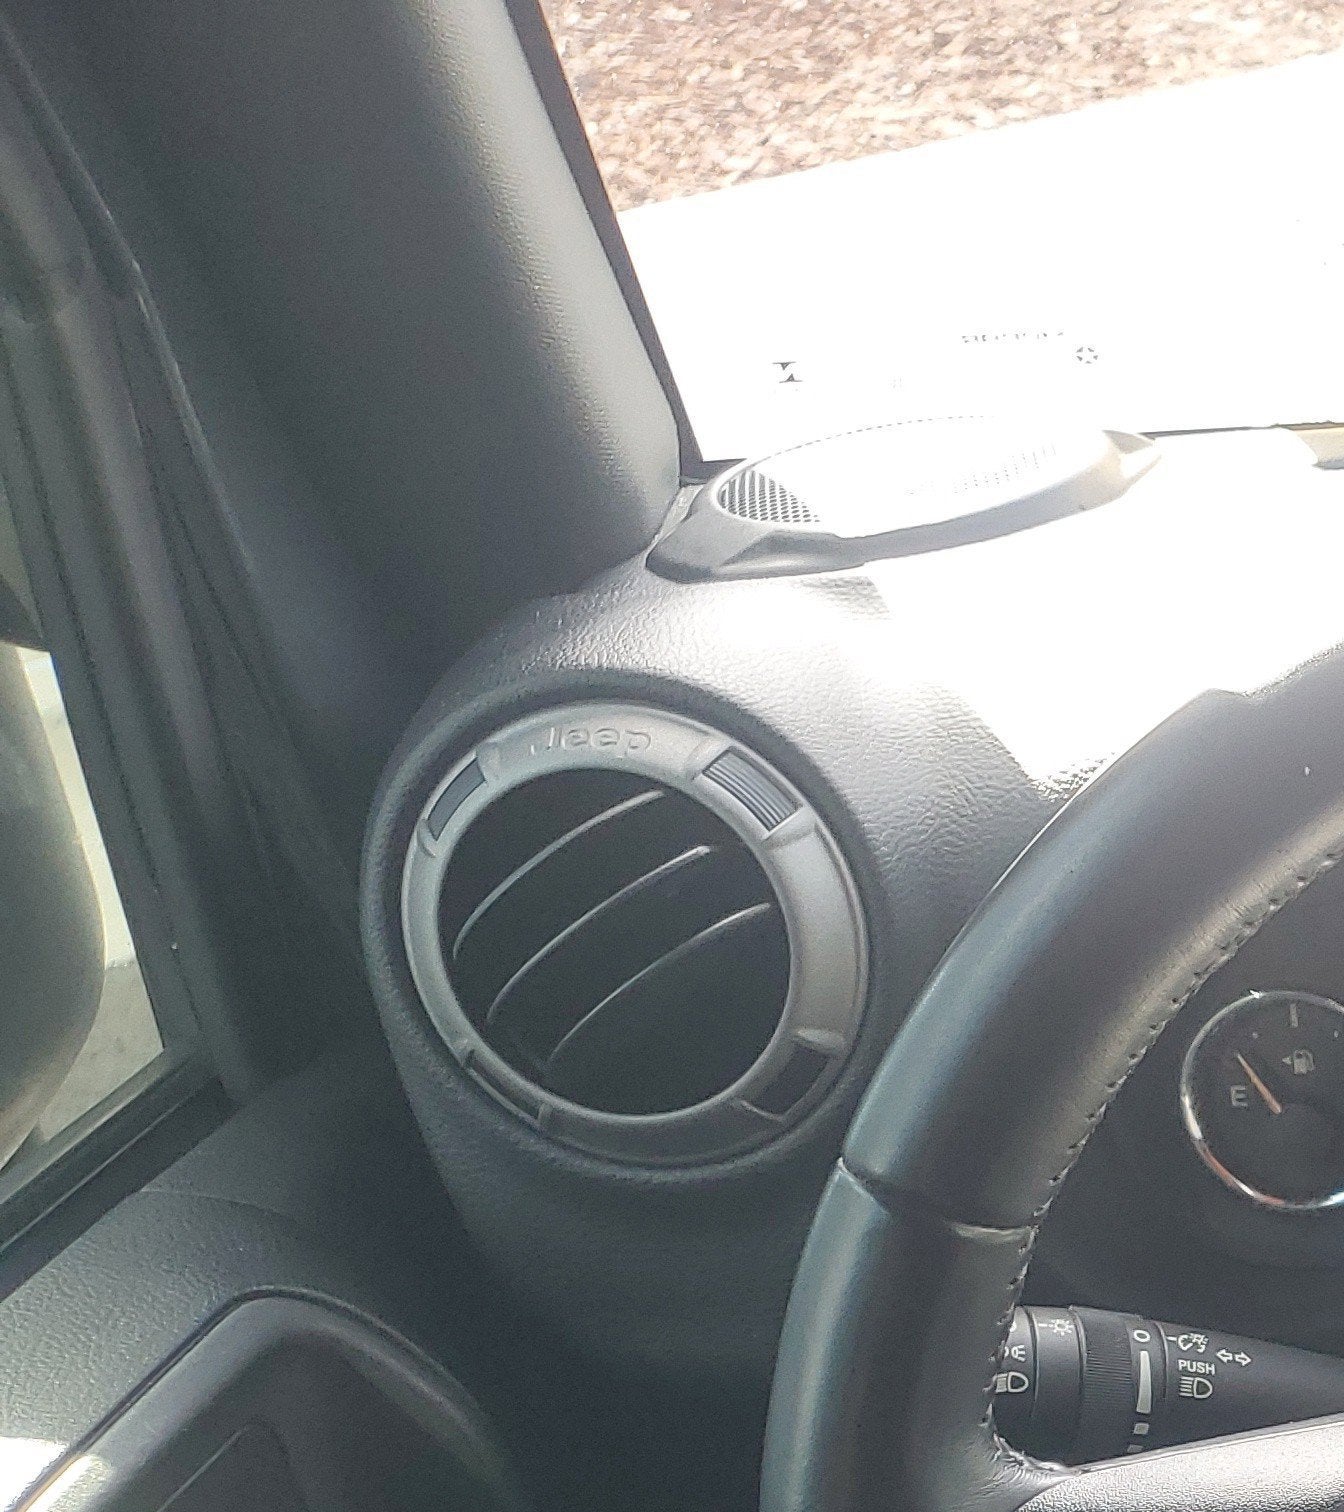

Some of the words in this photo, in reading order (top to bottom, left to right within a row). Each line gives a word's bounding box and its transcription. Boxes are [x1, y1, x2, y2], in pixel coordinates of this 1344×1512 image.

[530, 726, 652, 758] Jeep
[1230, 1085, 1249, 1107] E
[1178, 1359, 1216, 1376] PUSH
